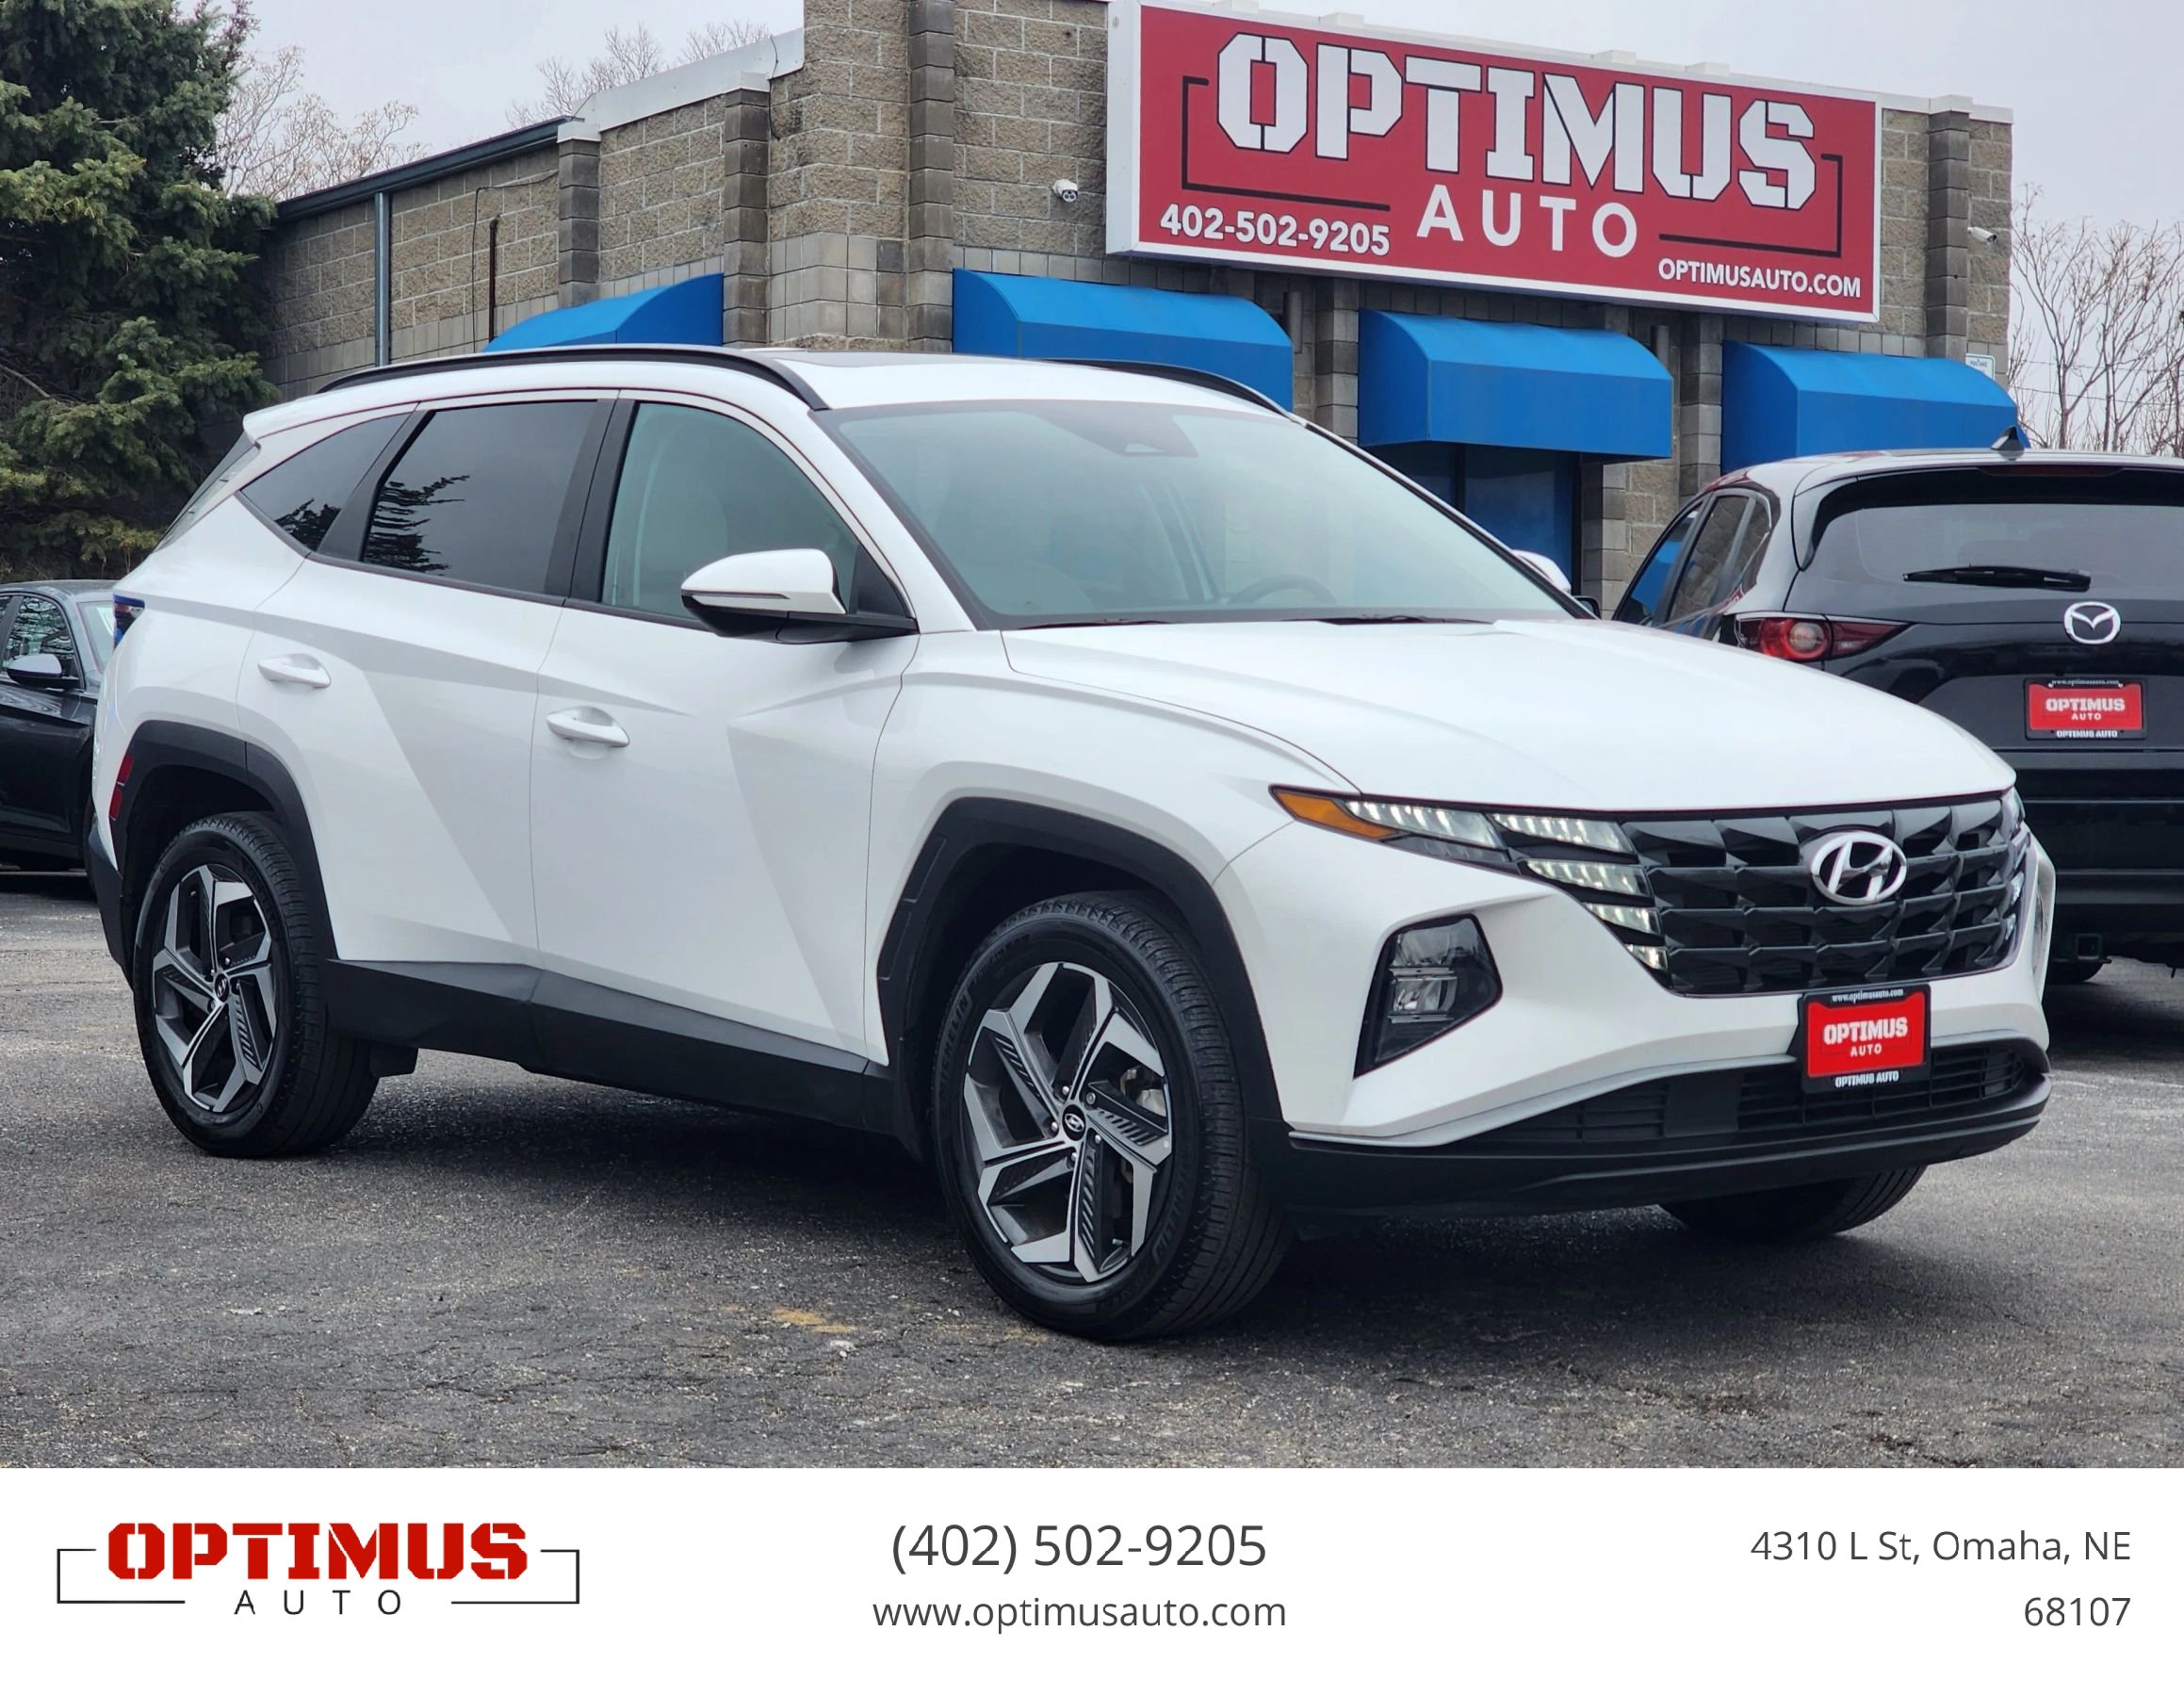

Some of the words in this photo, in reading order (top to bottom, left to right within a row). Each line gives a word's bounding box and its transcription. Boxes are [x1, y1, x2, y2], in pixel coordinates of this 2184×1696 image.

[1216, 32, 1817, 211] OPTIMUS
[1160, 203, 1391, 256] 402-502-9205
[1416, 184, 1638, 258] AUTO
[1658, 257, 1862, 299] OPTIMUSAUTO.COM
[2045, 697, 2126, 711] OPTIMUS
[2071, 712, 2102, 721] AUTO
[2056, 730, 2094, 739] OPTIMUS
[1832, 988, 1904, 1003] www.optimusauto.com
[1823, 1017, 1909, 1045] OPTIMUS
[1850, 1043, 1882, 1057] AUTO
[1834, 1072, 1875, 1088] OPTIMUS
[1876, 1070, 1899, 1084] AUTO
